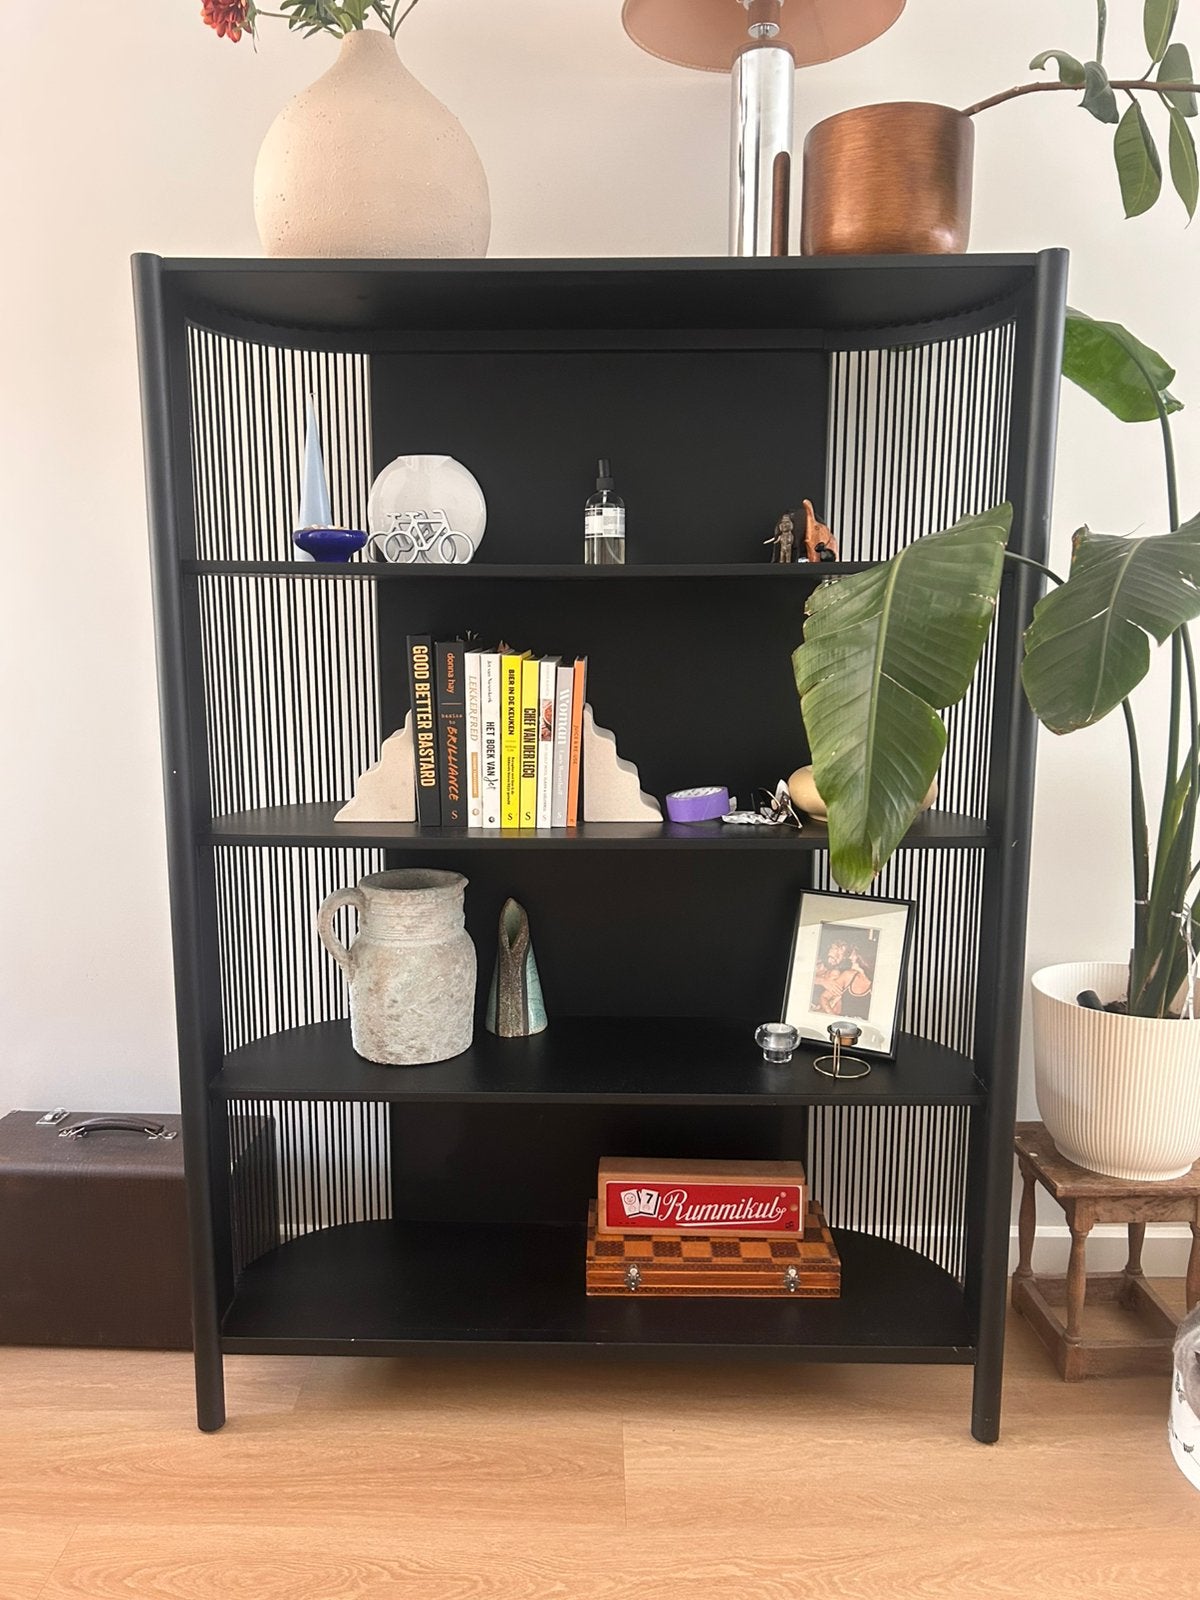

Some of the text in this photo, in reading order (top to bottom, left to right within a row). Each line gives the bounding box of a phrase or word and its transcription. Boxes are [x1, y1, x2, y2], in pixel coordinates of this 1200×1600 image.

[446, 652, 455, 694] donna hay
[508, 686, 515, 695] IN
[508, 696, 515, 706] DE
[412, 645, 436, 787] GOOD BETTER BASTARD
[468, 675, 479, 741] LEKKERFRED
[558, 688, 570, 745] Woman
[486, 721, 495, 736] HET
[522, 708, 536, 778] CHEF VAN DER LECQ
[446, 726, 460, 801] BRILLIANCE
[486, 739, 495, 759] BOEK
[486, 761, 495, 776] VAN
[646, 1192, 653, 1204] 7
